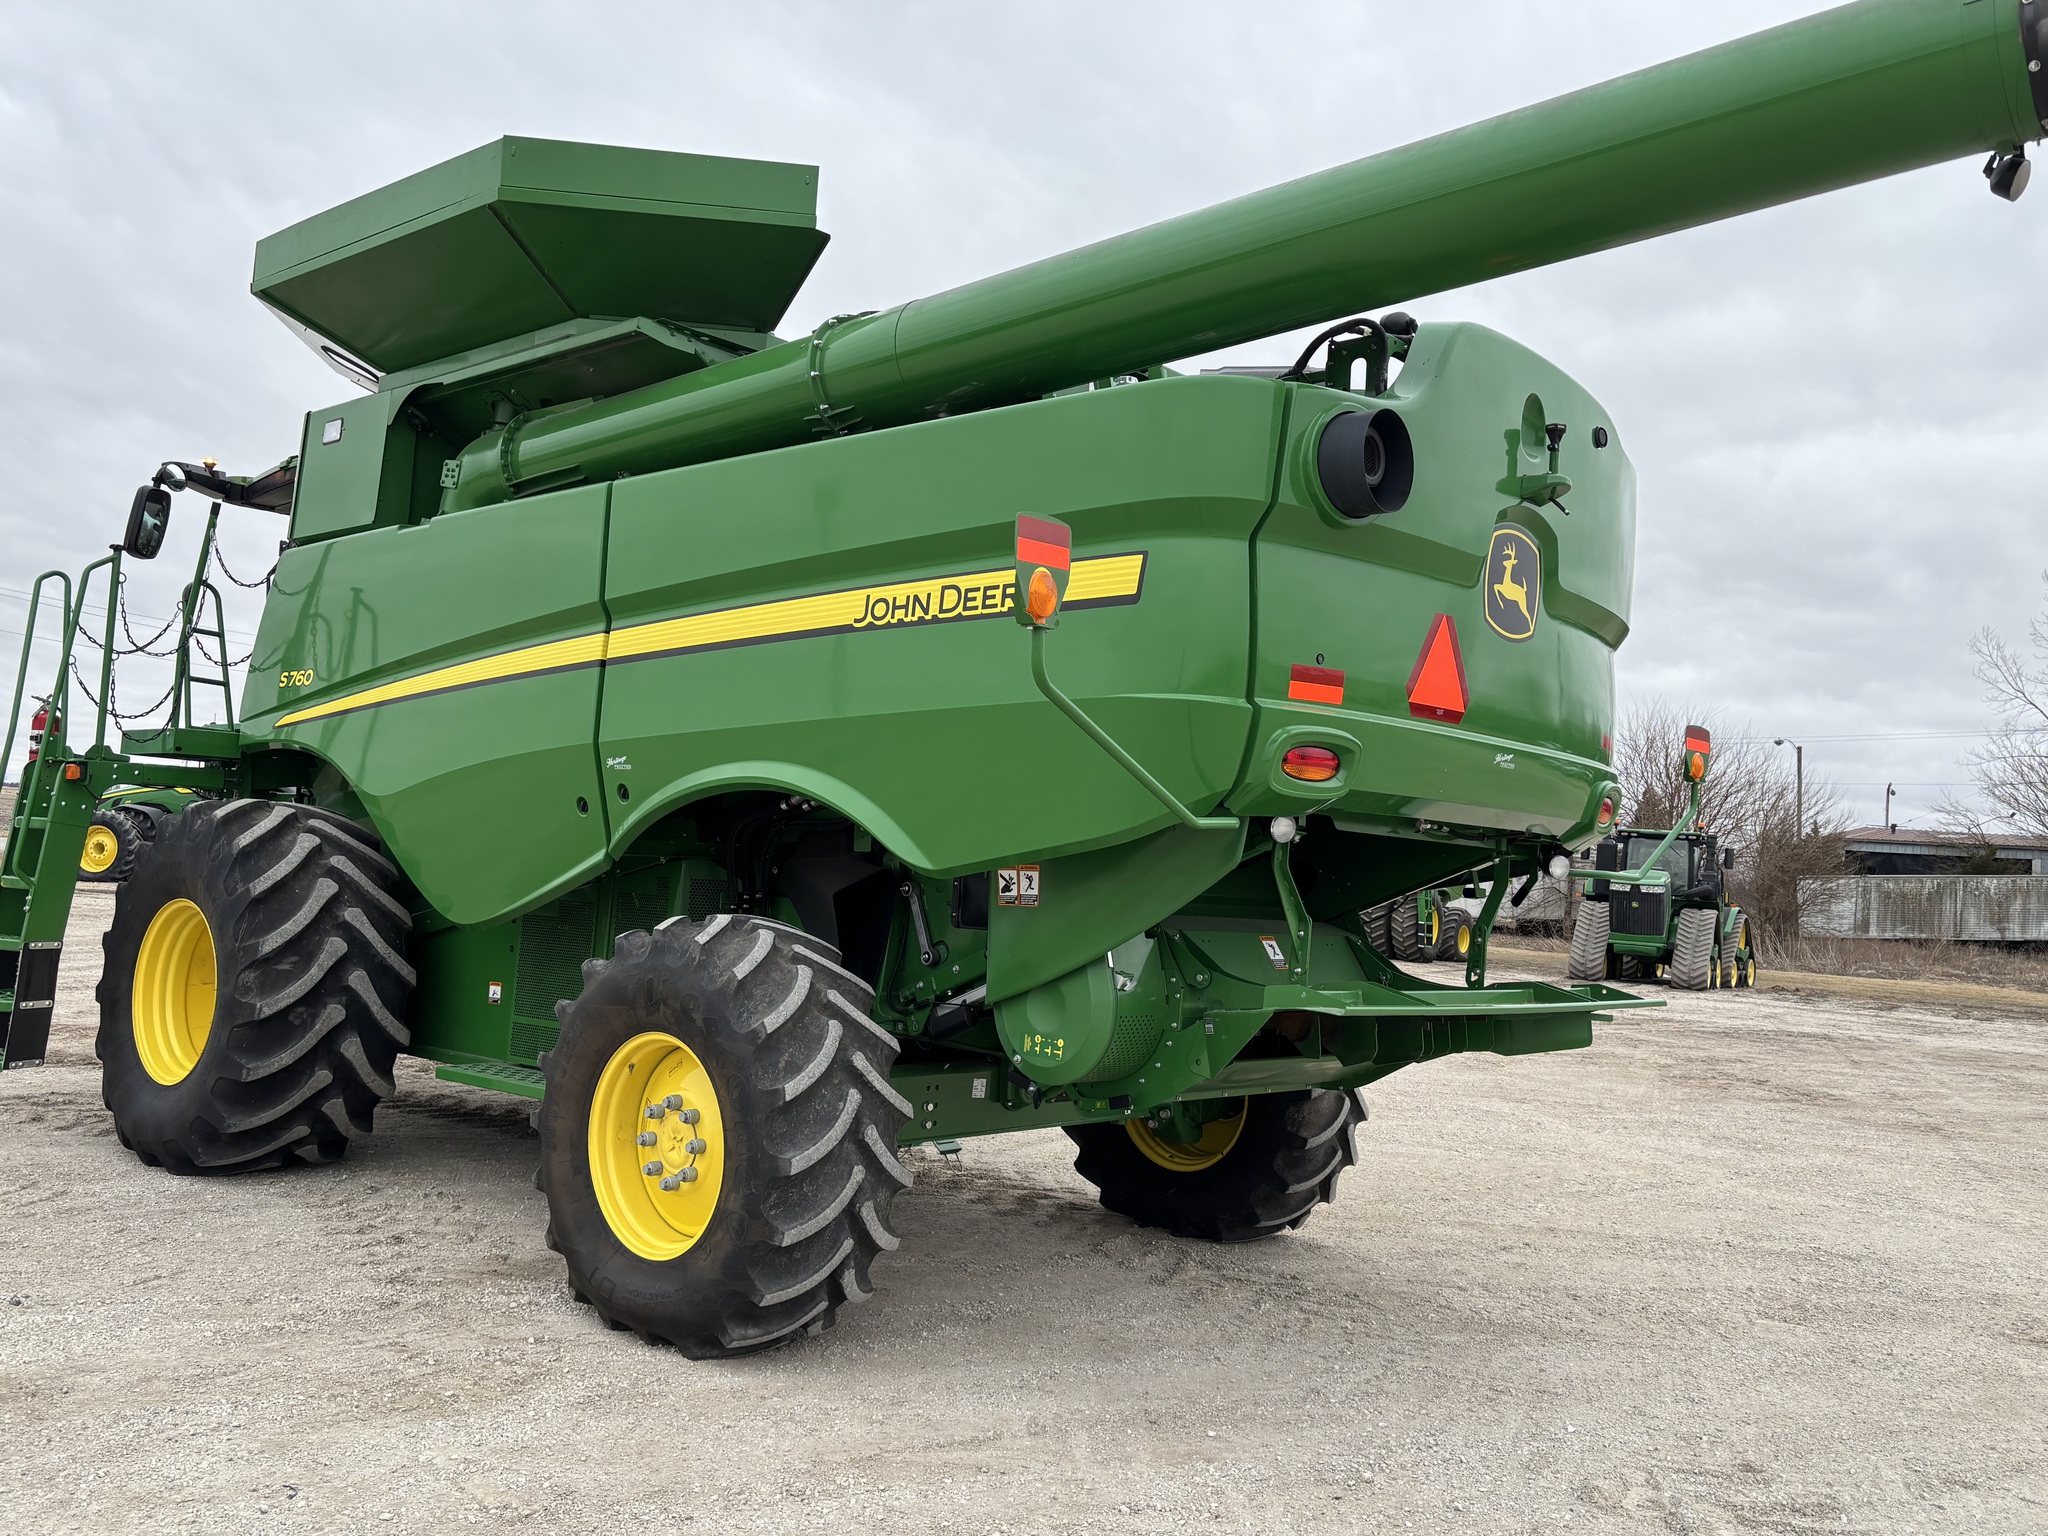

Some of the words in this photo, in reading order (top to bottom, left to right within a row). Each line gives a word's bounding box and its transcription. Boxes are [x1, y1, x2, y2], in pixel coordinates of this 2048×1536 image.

[853, 592, 932, 624] JOHN
[939, 584, 1015, 614] DEER
[279, 669, 314, 688] S760
